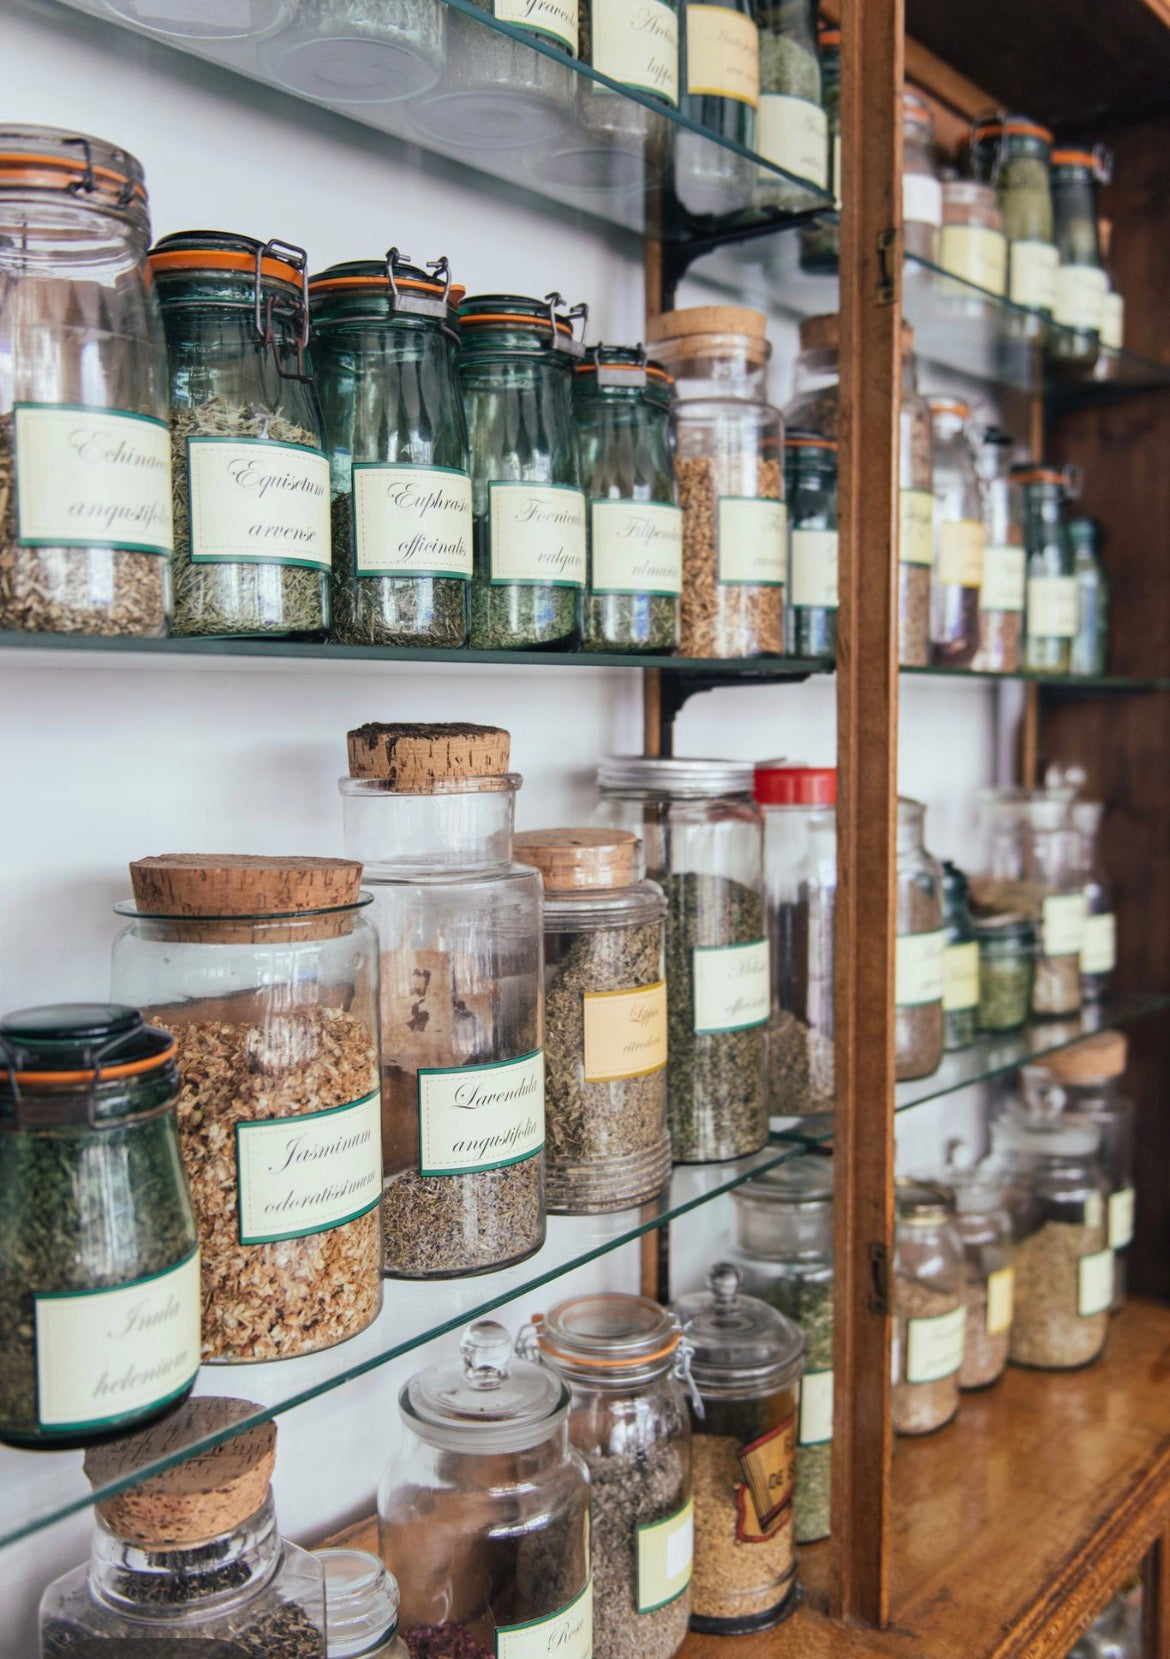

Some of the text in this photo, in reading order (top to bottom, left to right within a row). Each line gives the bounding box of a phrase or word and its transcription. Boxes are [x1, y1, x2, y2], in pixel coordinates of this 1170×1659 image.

[227, 458, 324, 498] Equisetum
[248, 522, 317, 543] arvense
[268, 1128, 371, 1175] Jasminum
